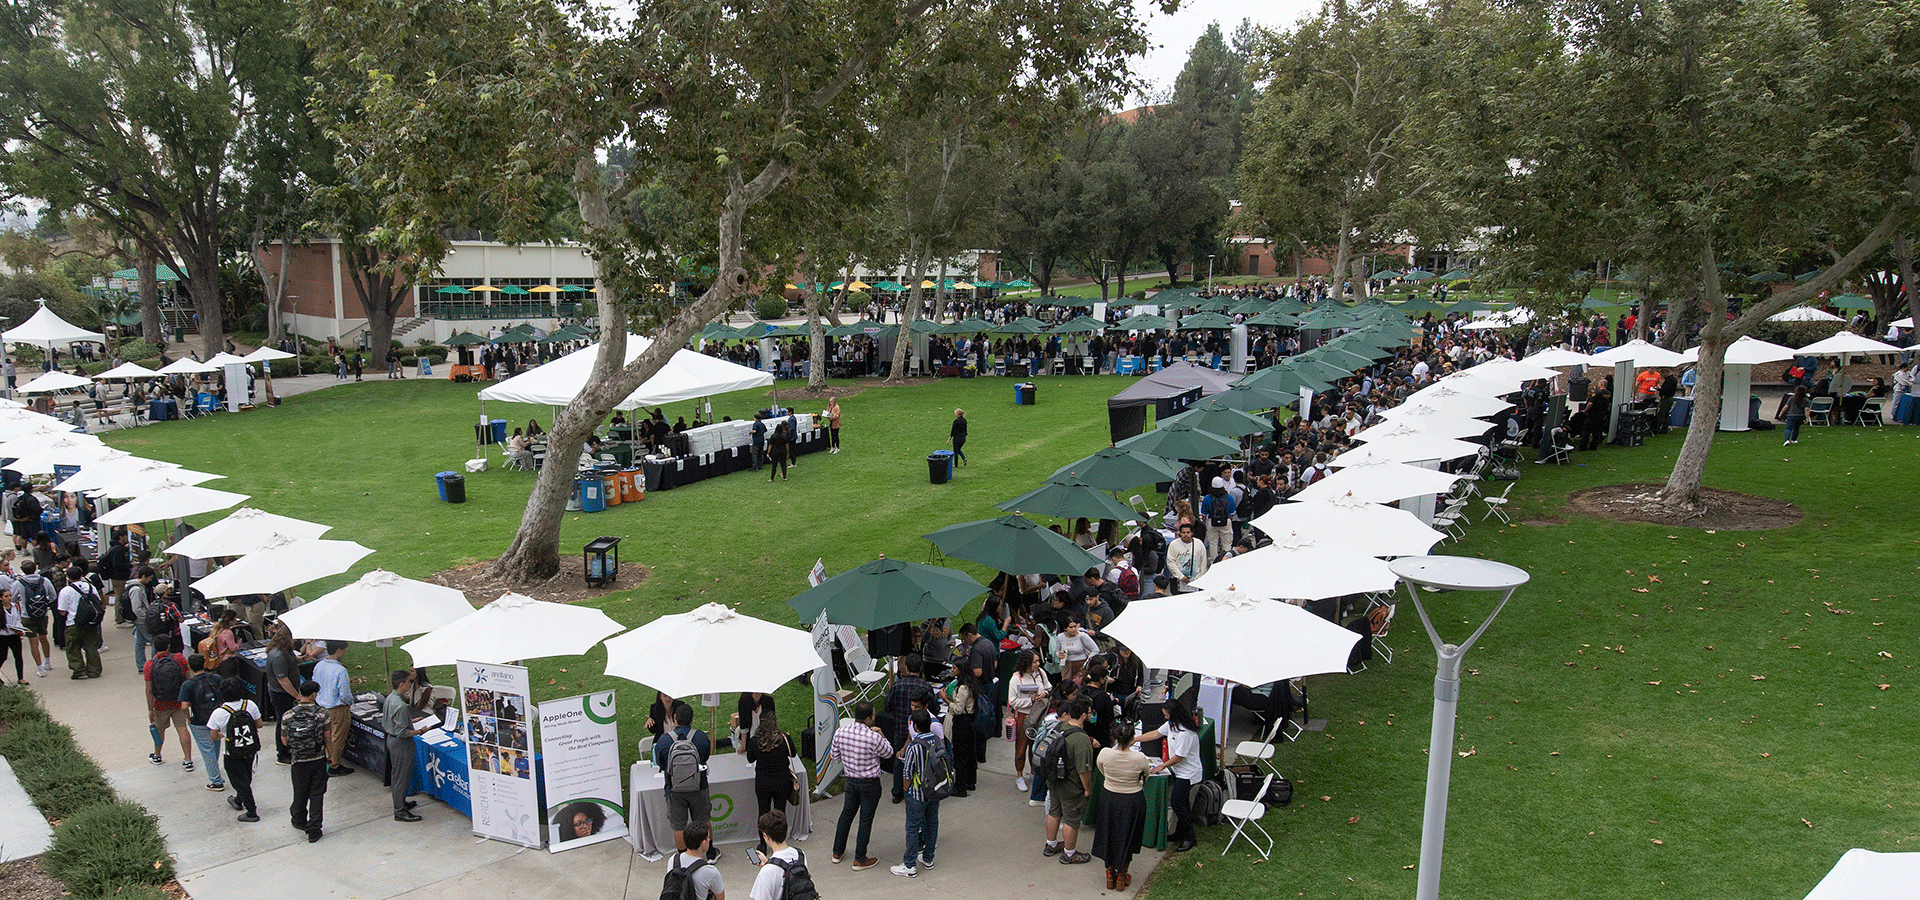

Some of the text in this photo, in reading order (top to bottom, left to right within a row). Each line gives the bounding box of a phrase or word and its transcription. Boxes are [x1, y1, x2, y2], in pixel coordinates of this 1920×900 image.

[619, 477, 628, 494] G
[491, 671, 514, 680] arellano
[543, 711, 583, 722] AppleOne
[544, 733, 573, 743] Connecting
[588, 738, 615, 747] Companies
[478, 774, 491, 827] REACH OUT
[711, 822, 738, 831] pleOne
